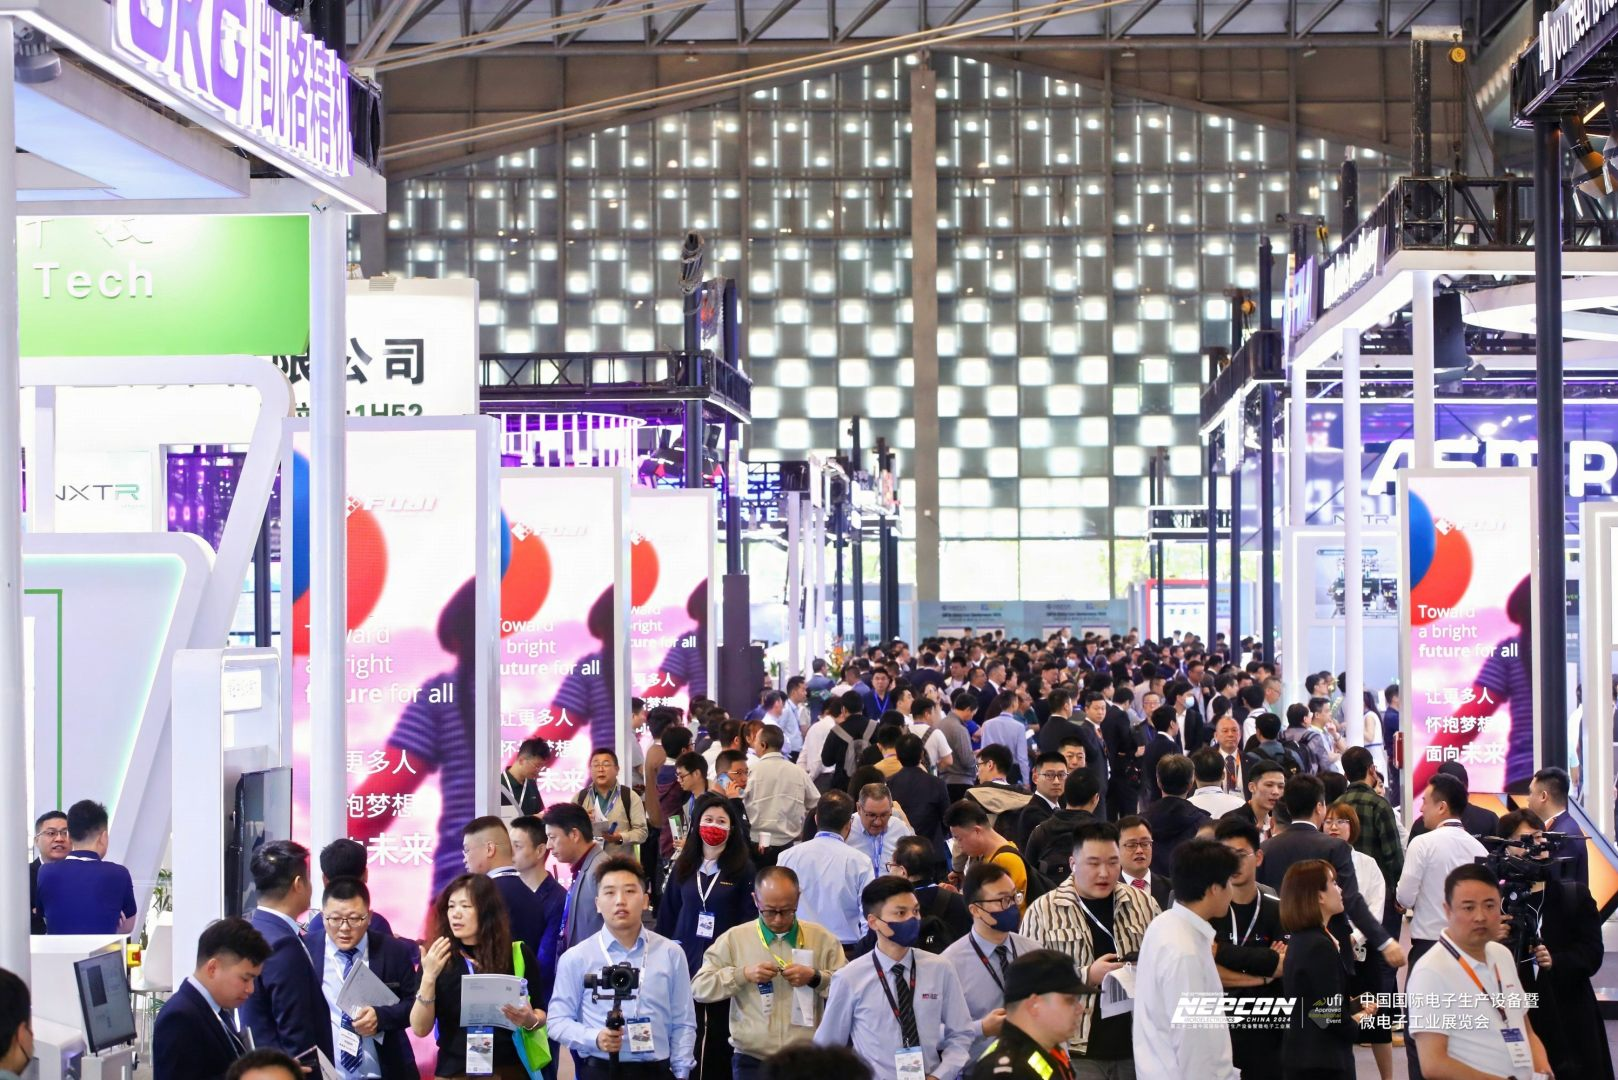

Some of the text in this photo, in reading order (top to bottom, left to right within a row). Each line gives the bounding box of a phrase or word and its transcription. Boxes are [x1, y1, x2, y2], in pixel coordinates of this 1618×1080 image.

[1539, 11, 1551, 76] All
[1550, 13, 1567, 80] you
[1568, 0, 1590, 48] need
[31, 258, 153, 299] Tech
[1418, 605, 1476, 618] Toward
[500, 618, 554, 633] oward
[632, 619, 663, 634] right
[1418, 625, 1477, 641] a bright
[507, 639, 557, 657] bright
[681, 635, 697, 648] all
[1419, 643, 1518, 657] future for all
[346, 654, 394, 680] ight
[500, 660, 600, 675] uture for all
[390, 682, 421, 704] for
[428, 683, 454, 704] all
[1425, 687, 1494, 704] 让更多人
[501, 740, 572, 757] 怀想
[1425, 742, 1505, 764] 面向未来
[350, 832, 434, 866] 未来
